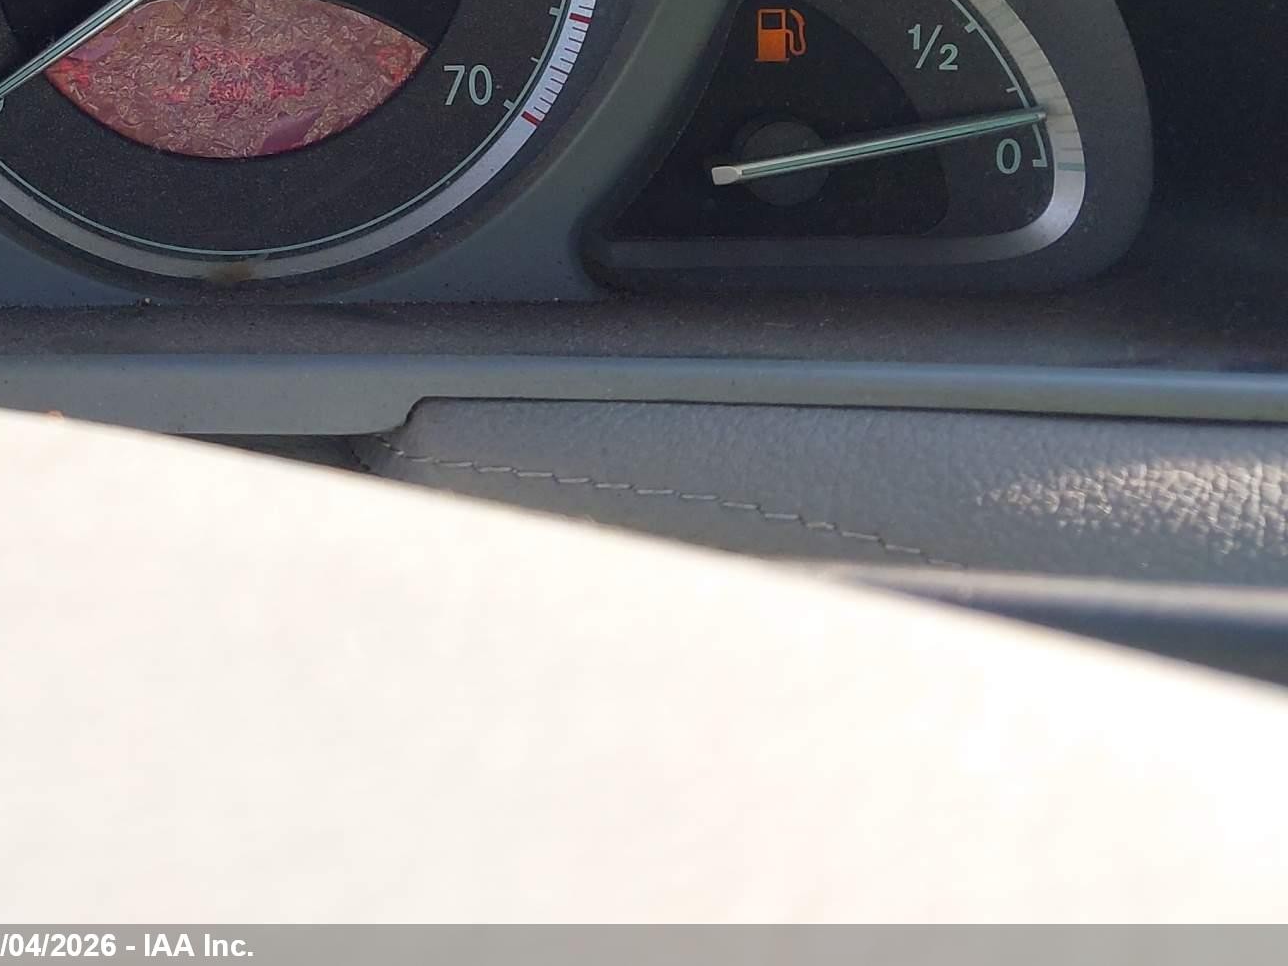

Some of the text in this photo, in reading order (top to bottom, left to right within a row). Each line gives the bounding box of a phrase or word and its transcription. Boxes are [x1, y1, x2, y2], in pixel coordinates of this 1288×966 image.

[907, 23, 959, 72] 1/2
[443, 64, 494, 107] 70
[995, 137, 1022, 175] 0
